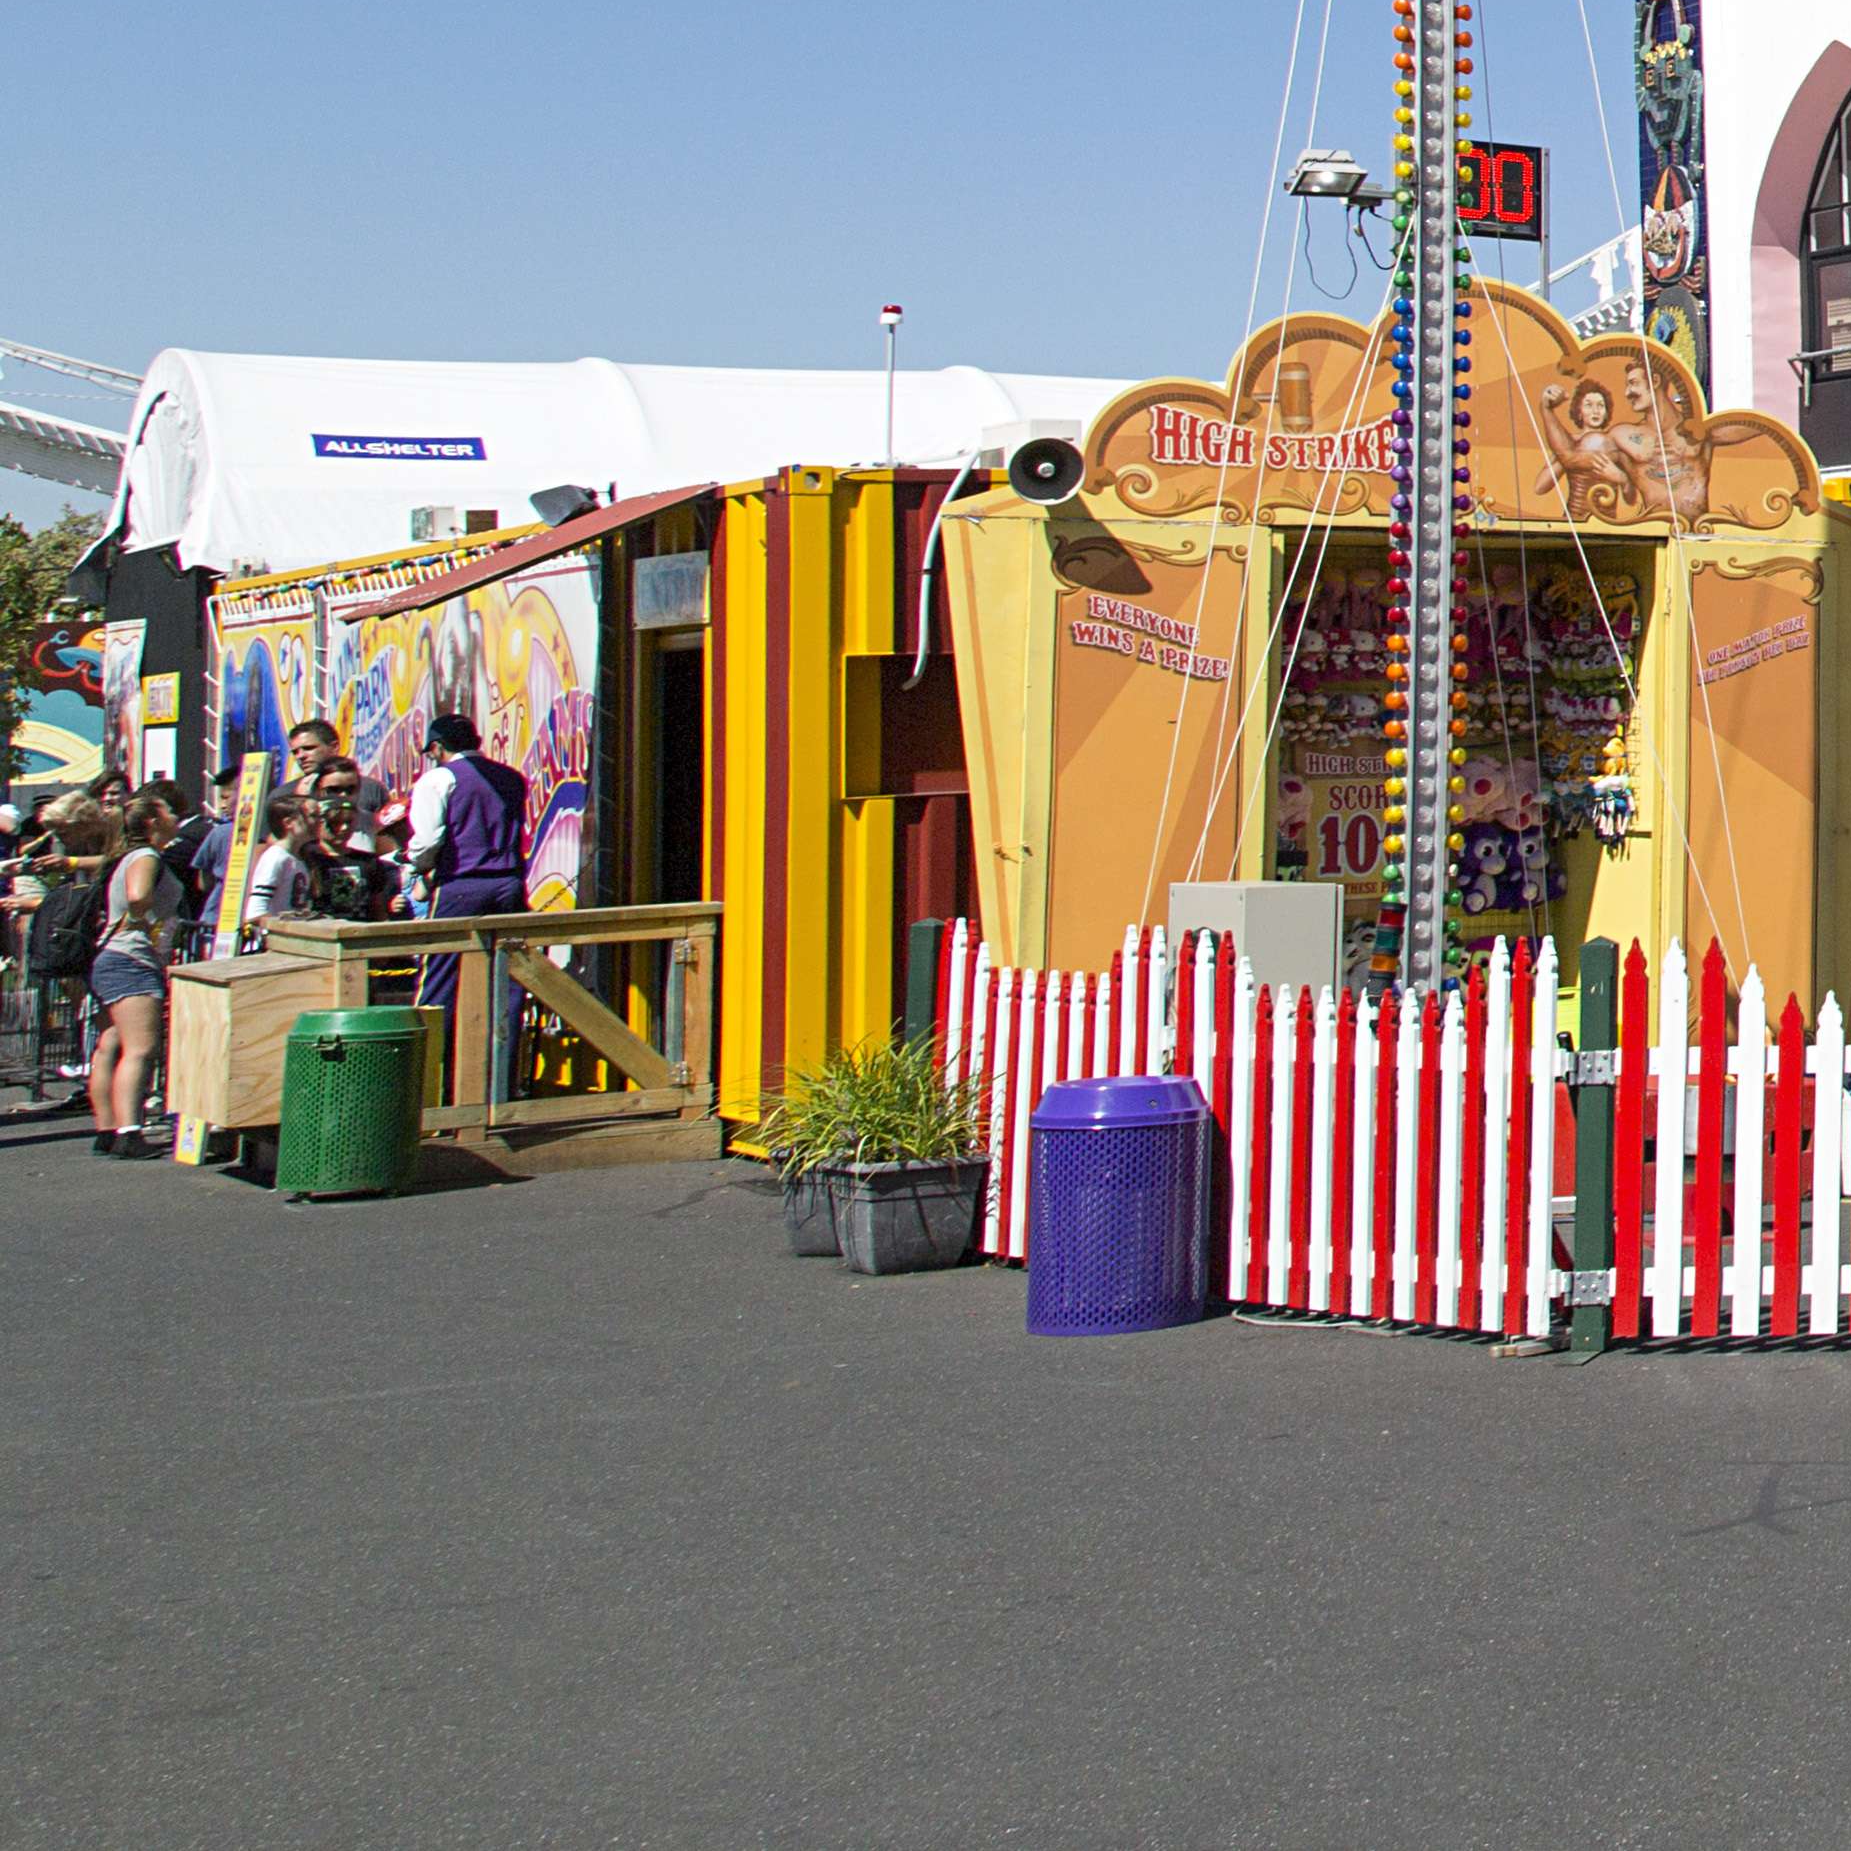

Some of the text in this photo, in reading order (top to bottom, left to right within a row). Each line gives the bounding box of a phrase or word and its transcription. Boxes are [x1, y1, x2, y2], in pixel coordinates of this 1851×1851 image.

[324, 440, 475, 456] ALLSHELTER
[1151, 405, 1398, 473] HIGH STRIKE
[1072, 621, 1231, 681] WINS A PRIZE!
[355, 653, 391, 726] PARK
[1306, 753, 1355, 774] HIGH
[1329, 784, 1391, 811] SCOR
[1318, 812, 1391, 878] 10
